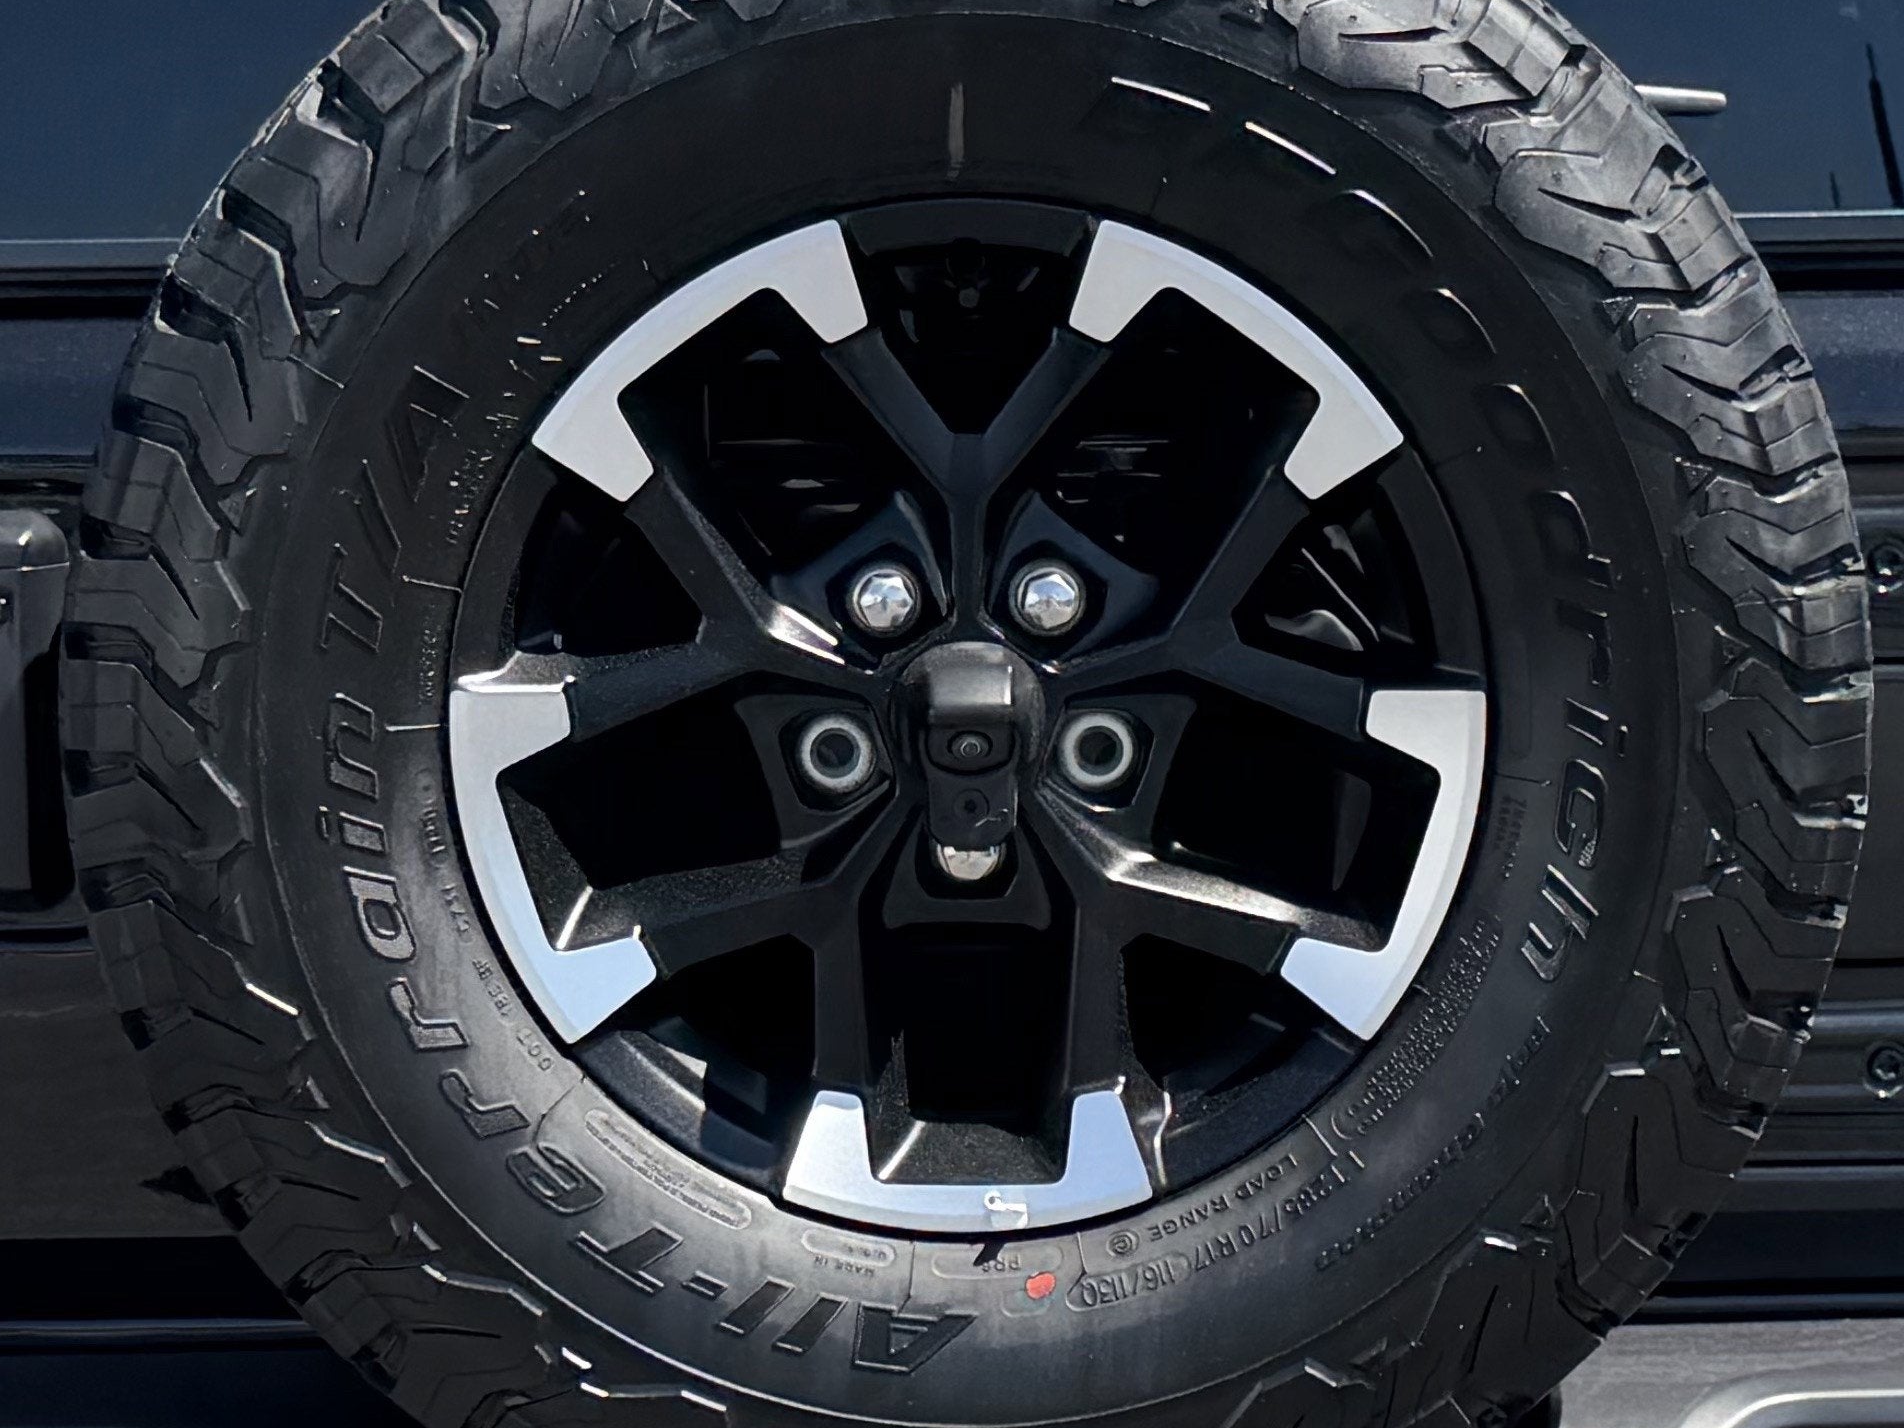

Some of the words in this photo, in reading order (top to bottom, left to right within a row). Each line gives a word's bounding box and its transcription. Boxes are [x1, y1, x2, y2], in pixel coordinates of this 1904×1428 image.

[1075, 65, 1628, 994] Goodrich
[305, 689, 976, 1377] All-Terrain
[1144, 1192, 1233, 1244] RANGE
[1230, 1150, 1300, 1203] LOAD
